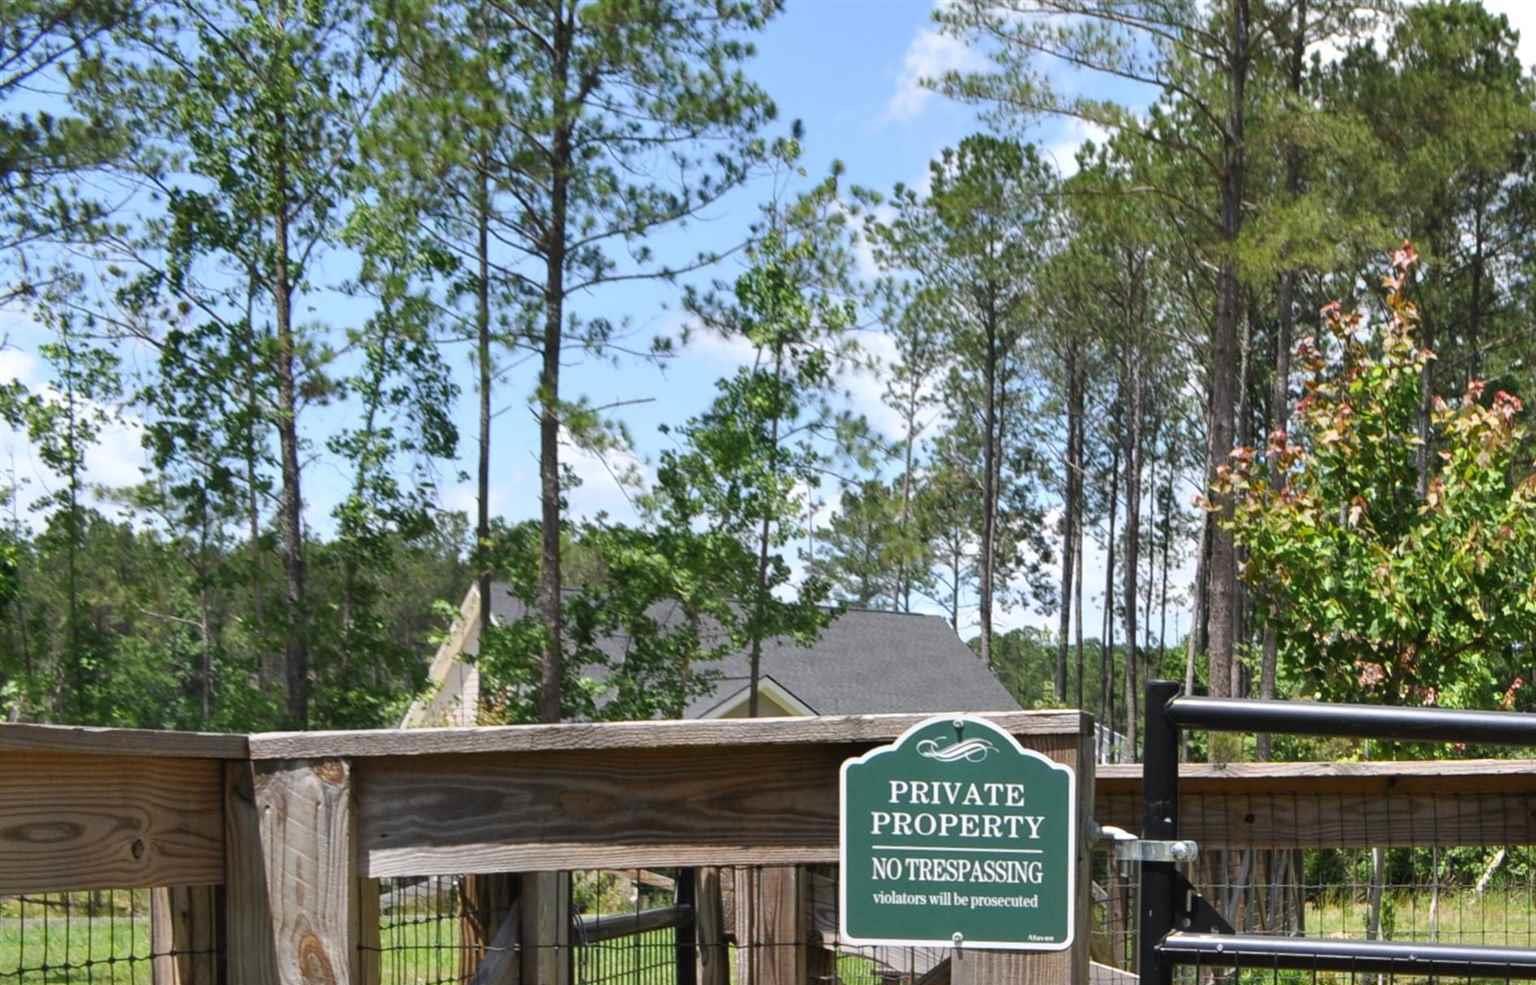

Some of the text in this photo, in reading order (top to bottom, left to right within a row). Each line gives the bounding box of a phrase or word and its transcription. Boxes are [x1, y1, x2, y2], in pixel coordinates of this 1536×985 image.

[889, 780, 1025, 807] PRIVATE
[870, 811, 1046, 839] PROPERTY
[871, 857, 1044, 884] NO TRESPASSING
[873, 891, 1039, 909] violators will be prosecuted
